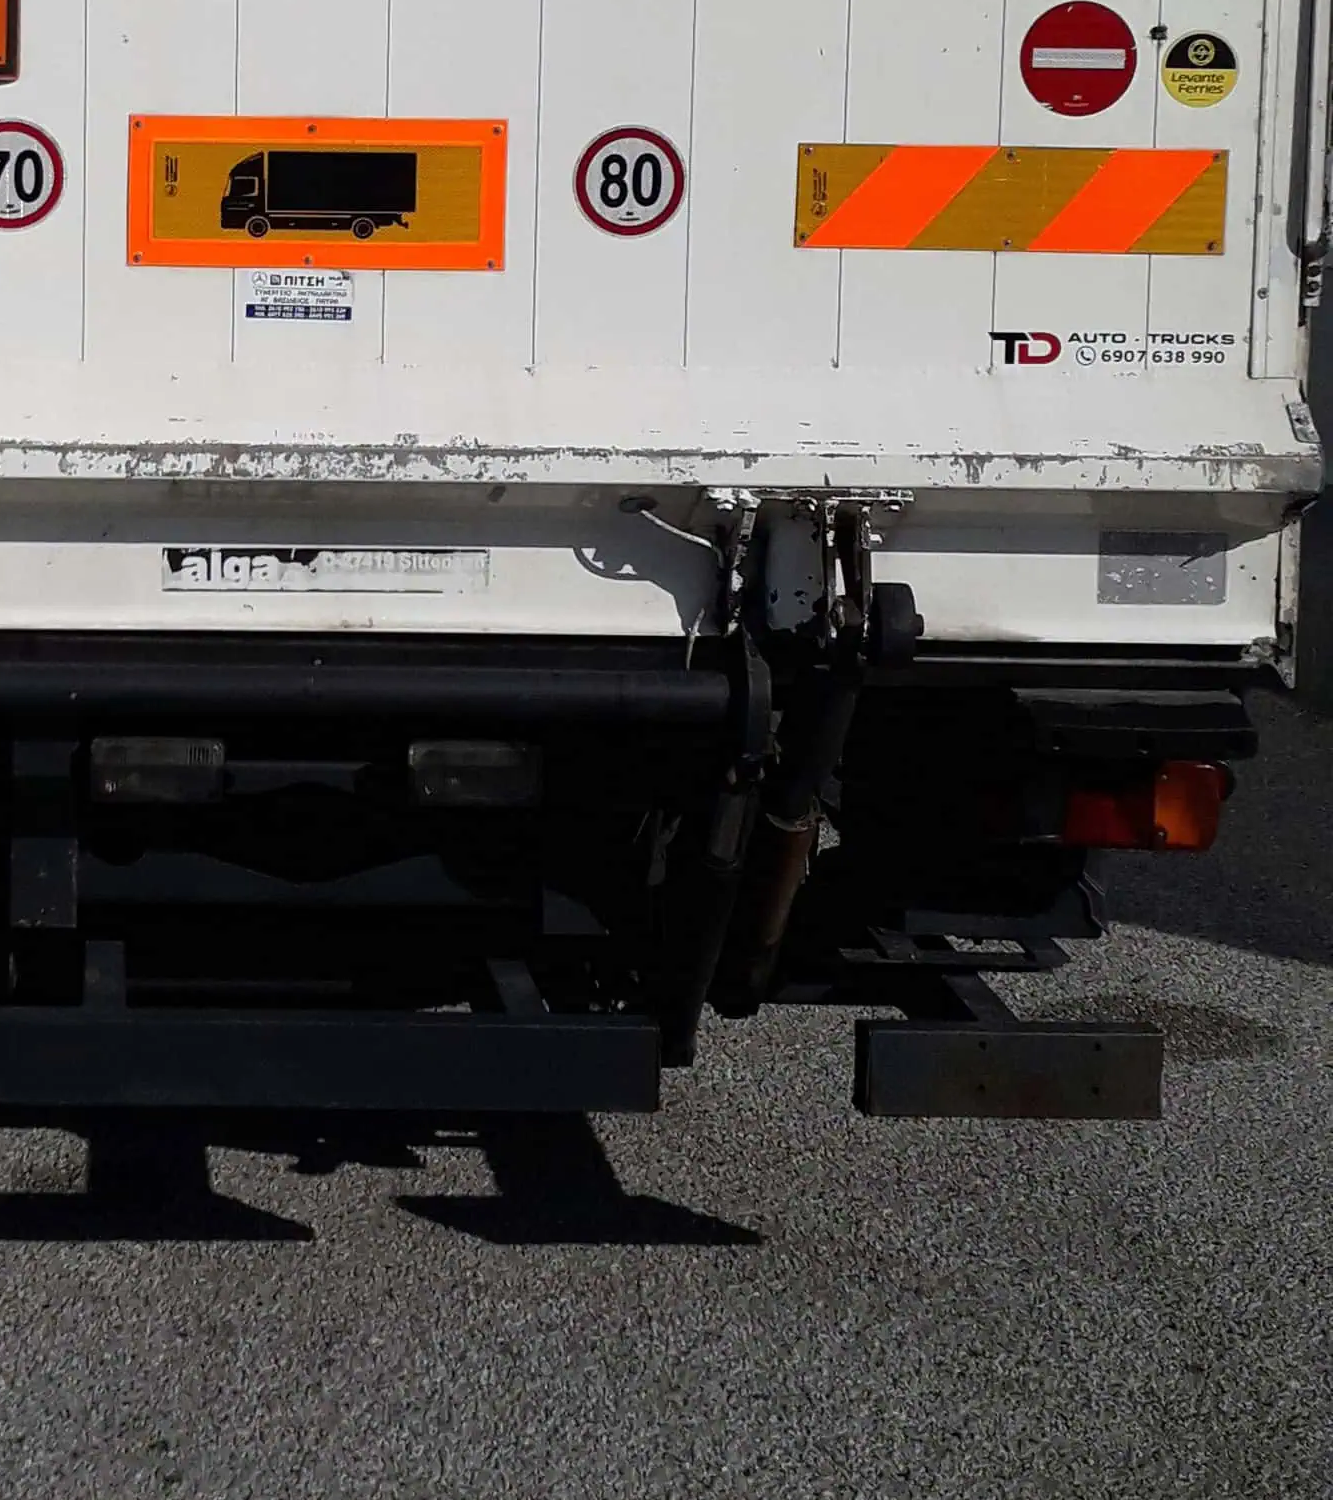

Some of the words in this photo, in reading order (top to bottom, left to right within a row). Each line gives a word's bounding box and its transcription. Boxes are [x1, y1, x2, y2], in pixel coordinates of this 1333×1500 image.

[1171, 72, 1225, 83] Levante
[1178, 84, 1224, 94] Ferries
[600, 153, 662, 208] 80
[1068, 333, 1126, 344] AUTO
[1148, 333, 1235, 345] TRUCKS
[988, 331, 1062, 365] TD
[1101, 350, 1145, 362] 6907
[1152, 351, 1185, 363] 638
[1192, 351, 1225, 364] 990
